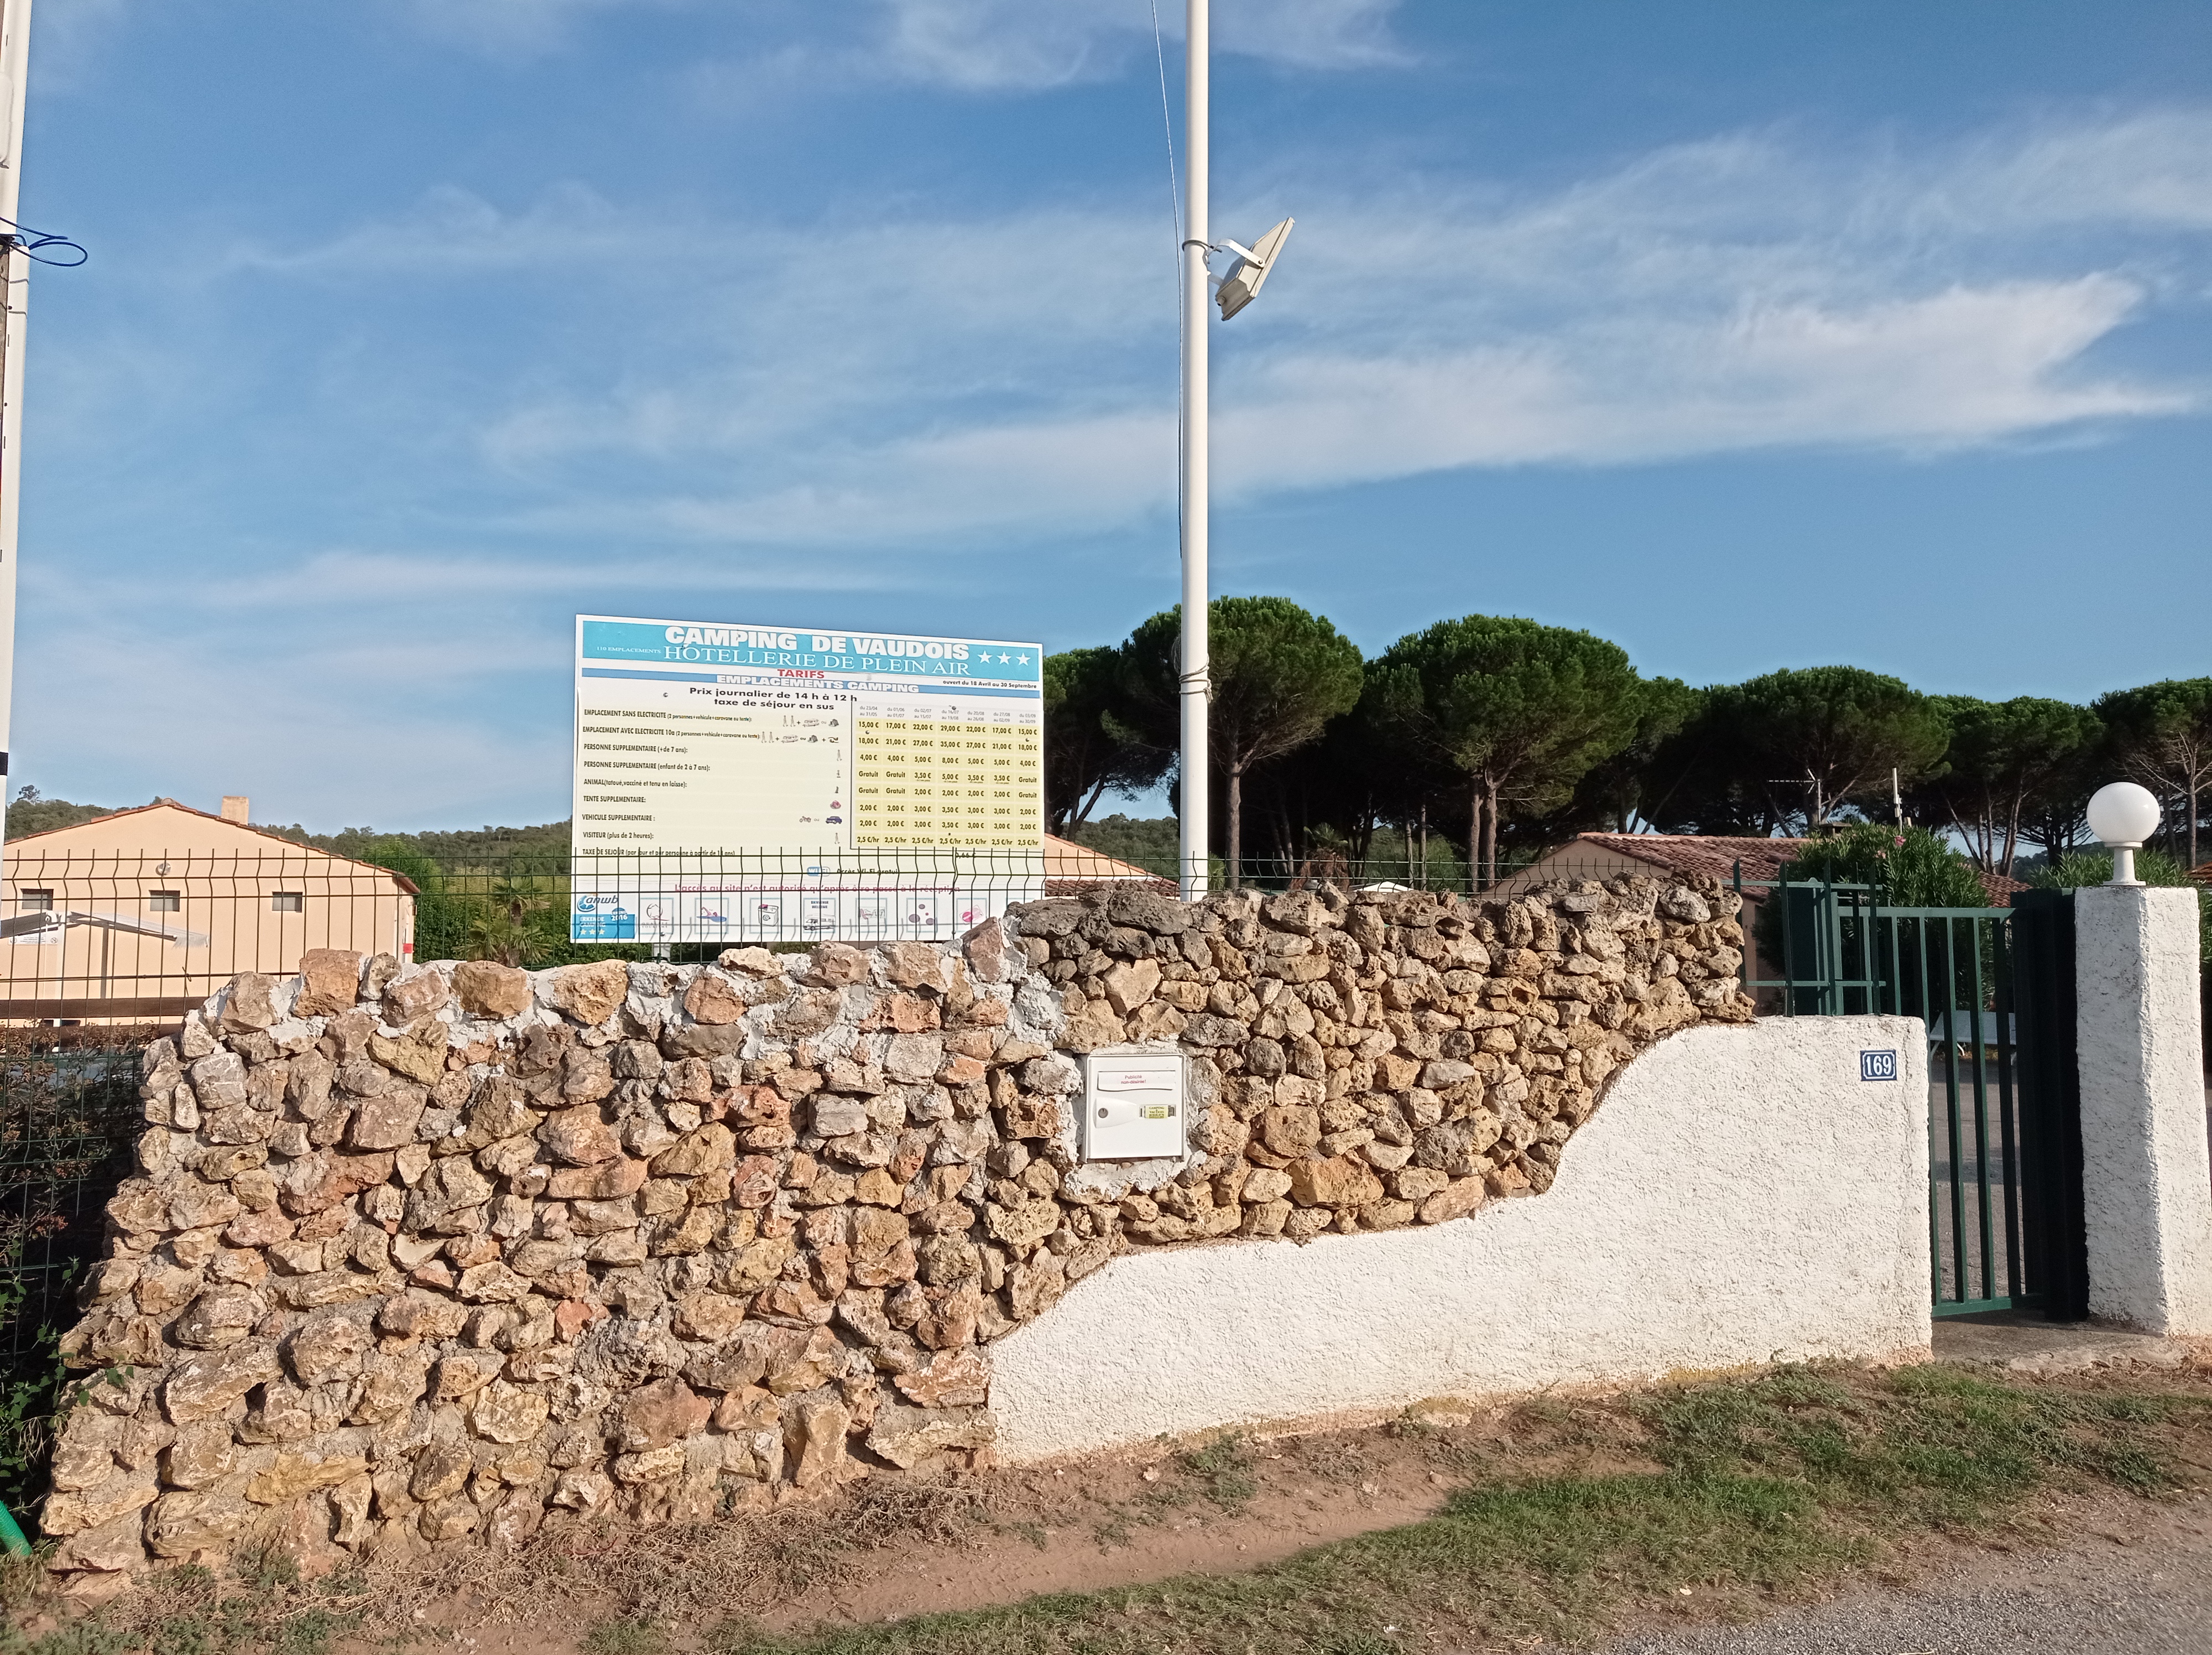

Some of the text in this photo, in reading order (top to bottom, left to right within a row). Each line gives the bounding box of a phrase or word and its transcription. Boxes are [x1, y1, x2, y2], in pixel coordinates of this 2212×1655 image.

[665, 626, 969, 660] CAMPING DE VAUDOIS
[823, 655, 854, 669] DE
[861, 657, 926, 673] PLEIN
[932, 662, 971, 675] AIR
[778, 669, 825, 679] TARIFS
[717, 675, 919, 693] EMPLACEMENTS CAMPING
[716, 689, 773, 698] journalier
[760, 700, 796, 709] séjour
[586, 895, 618, 904] anwb
[1866, 1055, 1892, 1076] 169
